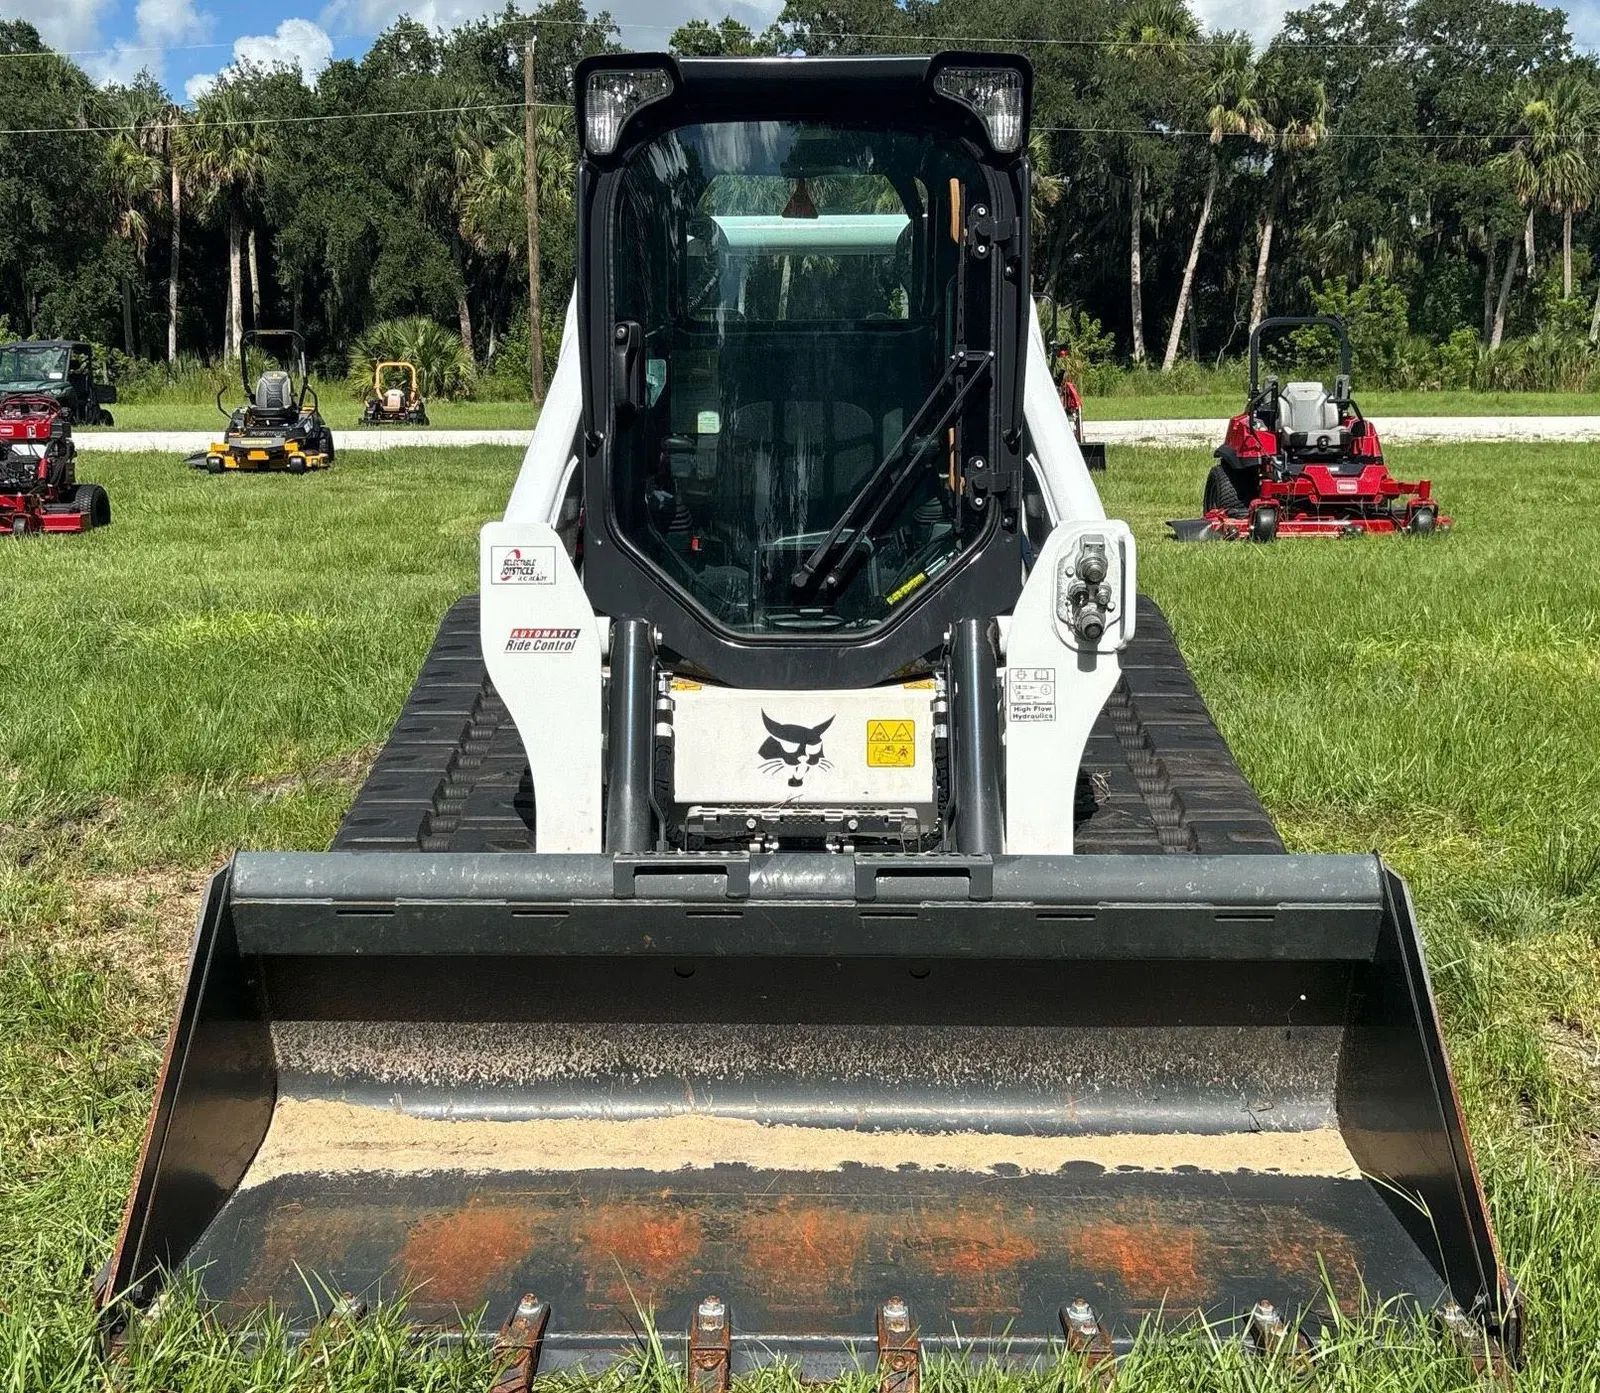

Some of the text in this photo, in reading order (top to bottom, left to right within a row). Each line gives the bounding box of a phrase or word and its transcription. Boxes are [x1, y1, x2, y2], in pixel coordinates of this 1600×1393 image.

[511, 629, 578, 638] AUTOMATIC
[505, 639, 577, 651] Ride Control
